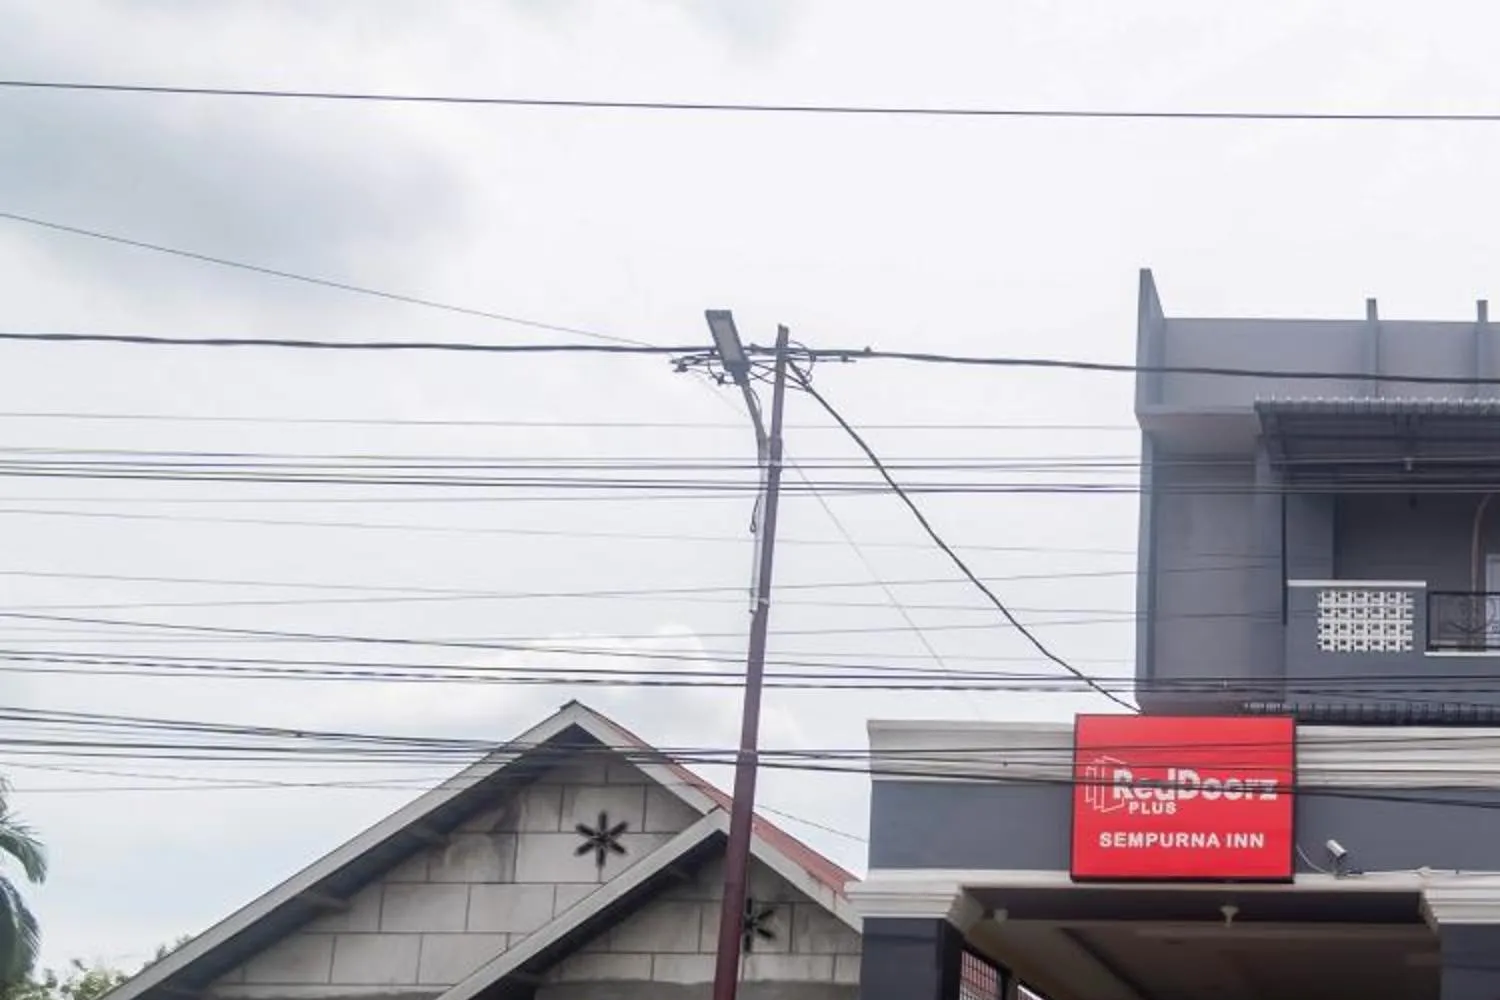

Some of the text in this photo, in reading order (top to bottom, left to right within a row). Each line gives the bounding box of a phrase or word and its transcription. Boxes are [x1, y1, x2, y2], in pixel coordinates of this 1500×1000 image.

[1113, 769, 1278, 800] RedDoorz
[1129, 802, 1177, 815] PLUS
[1099, 832, 1265, 848] SEMPURNA INN
